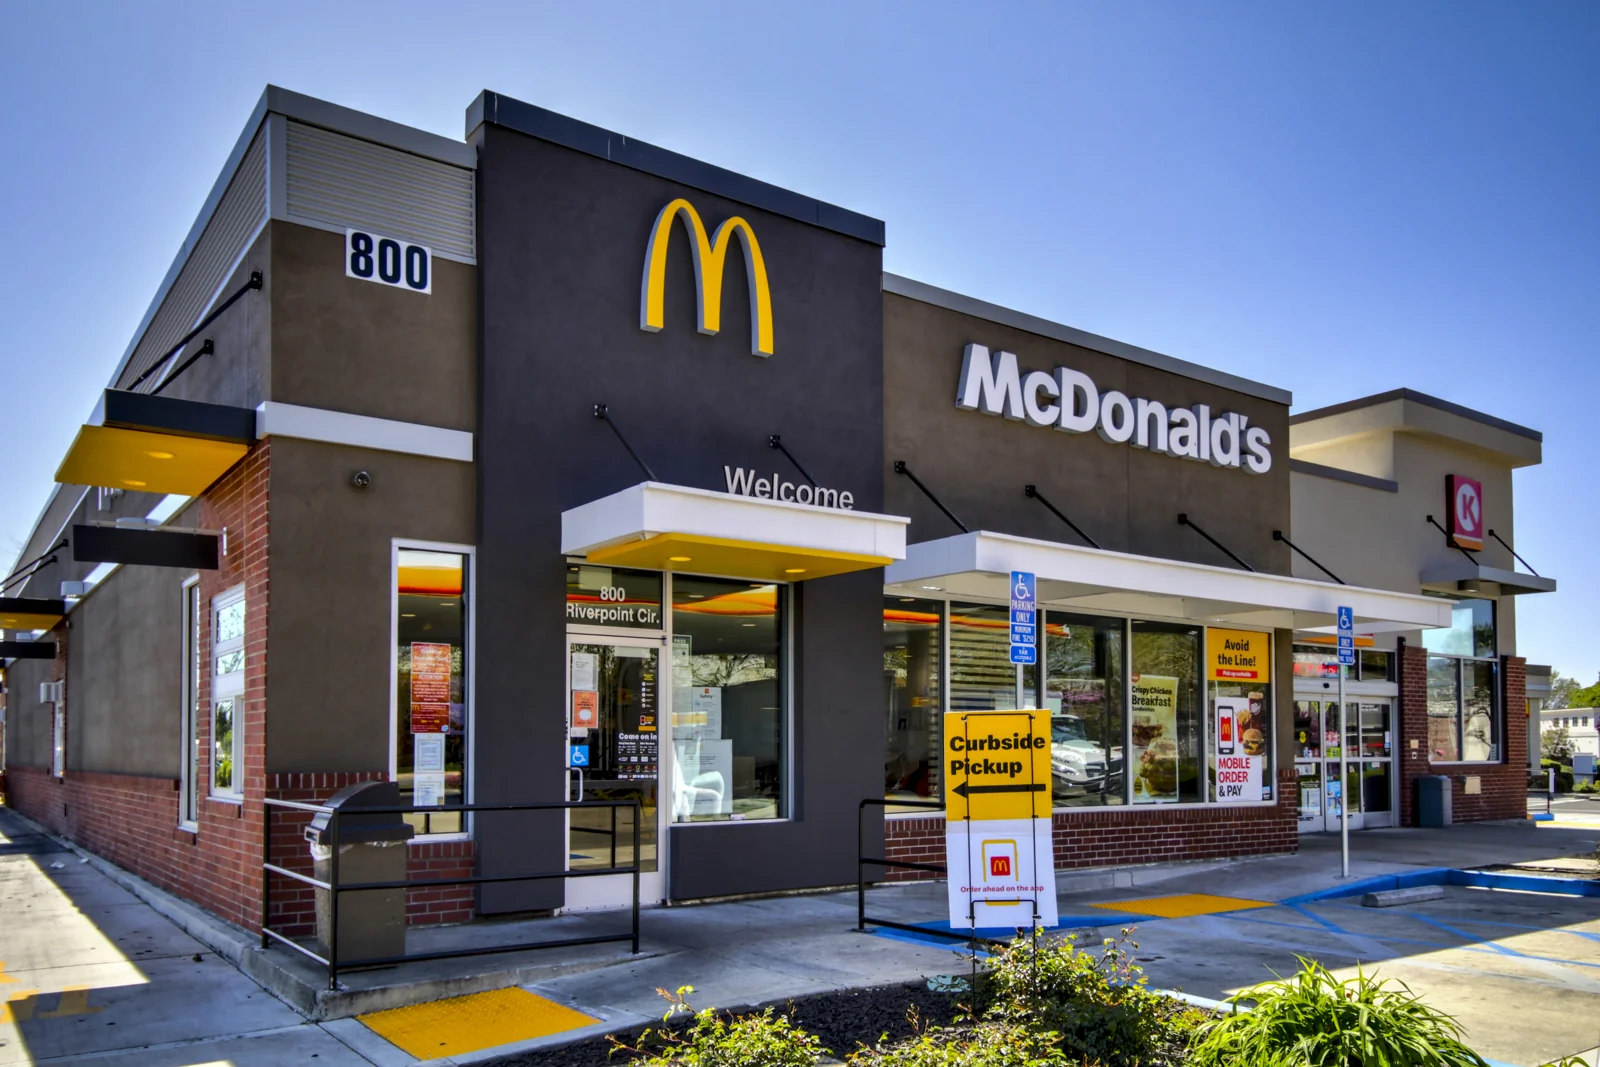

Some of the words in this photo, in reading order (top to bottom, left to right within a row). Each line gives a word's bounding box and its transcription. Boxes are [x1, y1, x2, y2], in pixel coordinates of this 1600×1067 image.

[350, 231, 428, 290] 800
[957, 343, 1272, 475] McDonald's
[723, 465, 854, 510] Welcome
[600, 586, 626, 602] 800
[1012, 599, 1035, 612] PARKING
[566, 603, 634, 623] Riverpoint
[637, 608, 660, 624] Cir.
[1015, 611, 1031, 623] ONLY
[1224, 639, 1250, 652] Avoid
[1218, 653, 1233, 666] the
[1234, 654, 1256, 667] Line!
[1132, 686, 1149, 696] Crispy
[1150, 687, 1173, 695] Chicken
[1132, 695, 1172, 707] Breakfast
[618, 732, 640, 740] Come
[949, 732, 1046, 752] Curbside
[950, 757, 1023, 778] Pickup
[1218, 757, 1251, 769] MOBILE
[1218, 771, 1249, 783] ORDER
[1218, 785, 1226, 797] &
[1227, 785, 1243, 797] PAY
